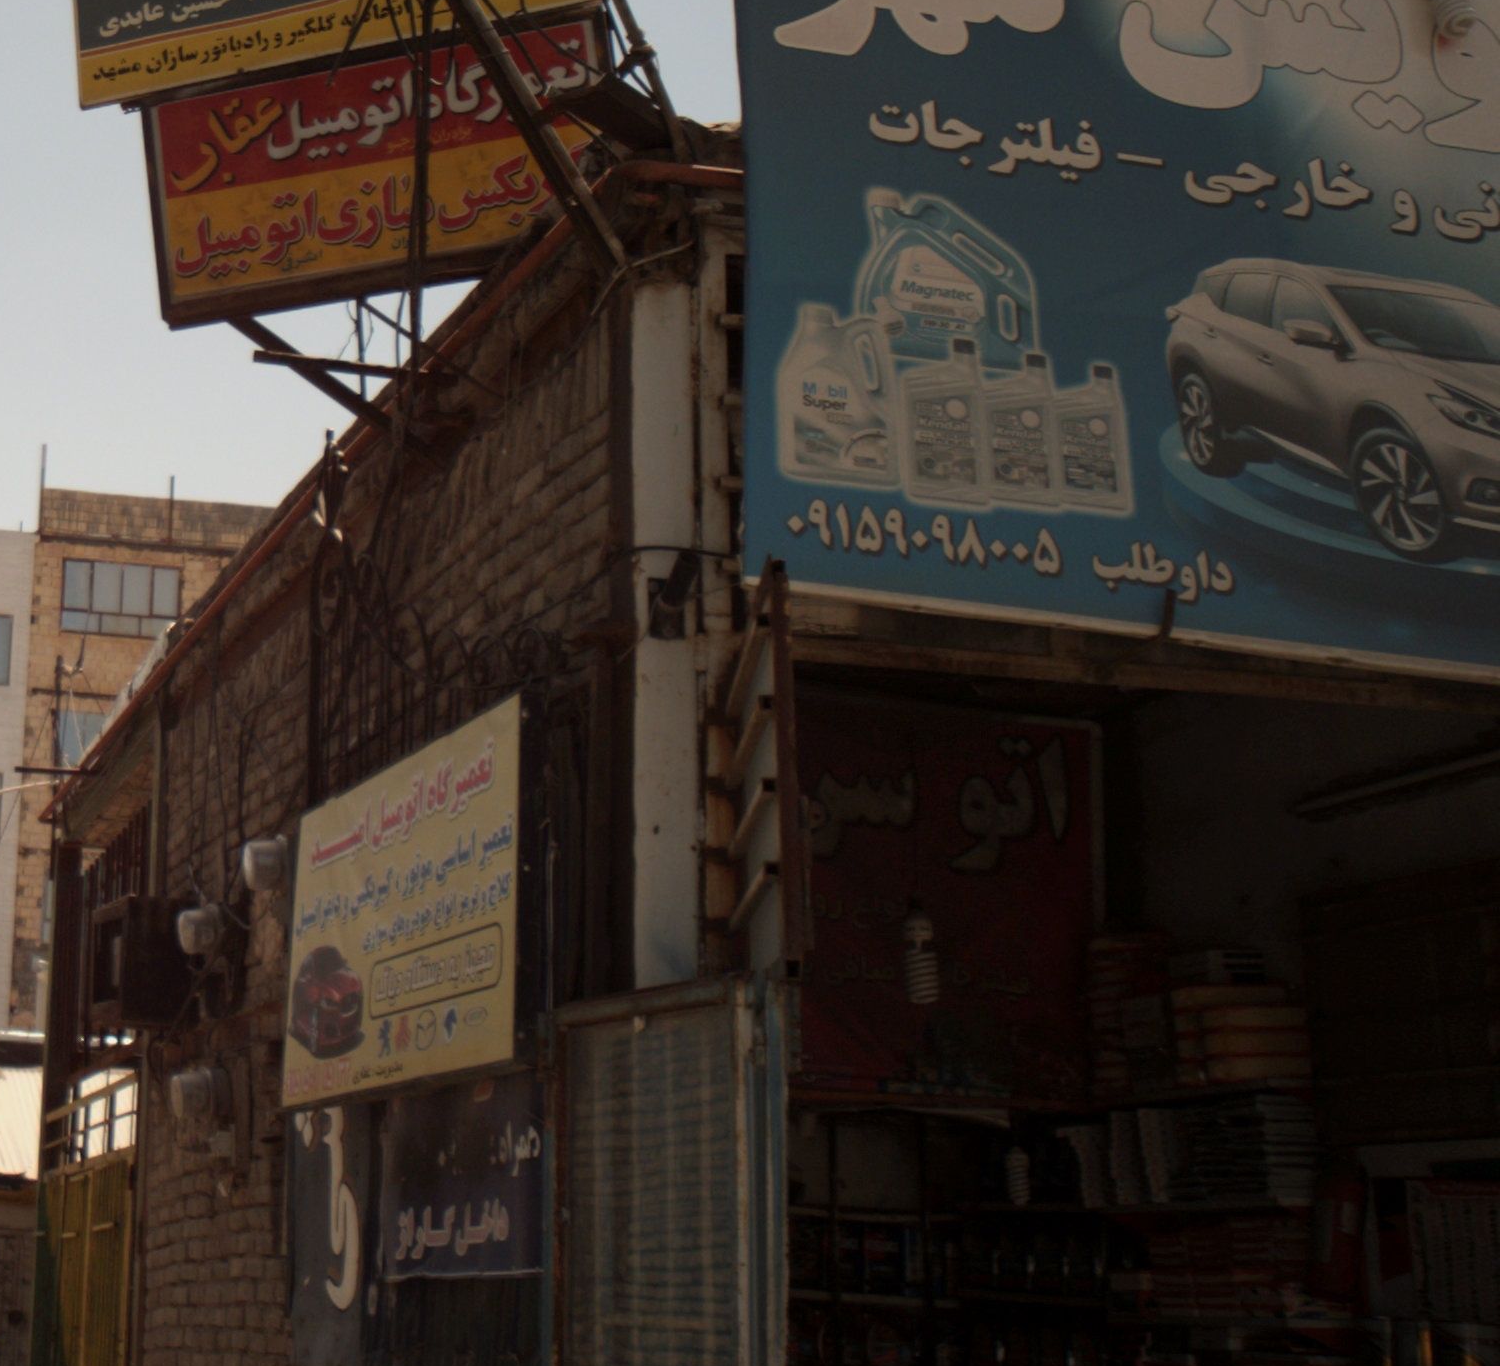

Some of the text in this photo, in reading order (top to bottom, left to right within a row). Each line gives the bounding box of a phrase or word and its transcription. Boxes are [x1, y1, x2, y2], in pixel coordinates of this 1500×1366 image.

[98, 2, 164, 38] عابدی
[274, 30, 284, 48] و
[286, 11, 337, 46] گلگیر
[92, 56, 142, 81] مشهد
[267, 69, 414, 160] اتومبیل
[868, 99, 985, 170] جات
[170, 95, 284, 192] عقاب
[986, 120, 1102, 183] فیلتر
[1183, 156, 1374, 219] خارجی
[1388, 187, 1421, 236] و
[174, 188, 317, 277] اتومبیل
[900, 279, 975, 301] Magnatec
[802, 380, 848, 399] Mbil
[802, 393, 848, 412] Super
[785, 496, 1237, 603] داوطلب ۰۹۱۵۹۰۹۸۰۰۵
